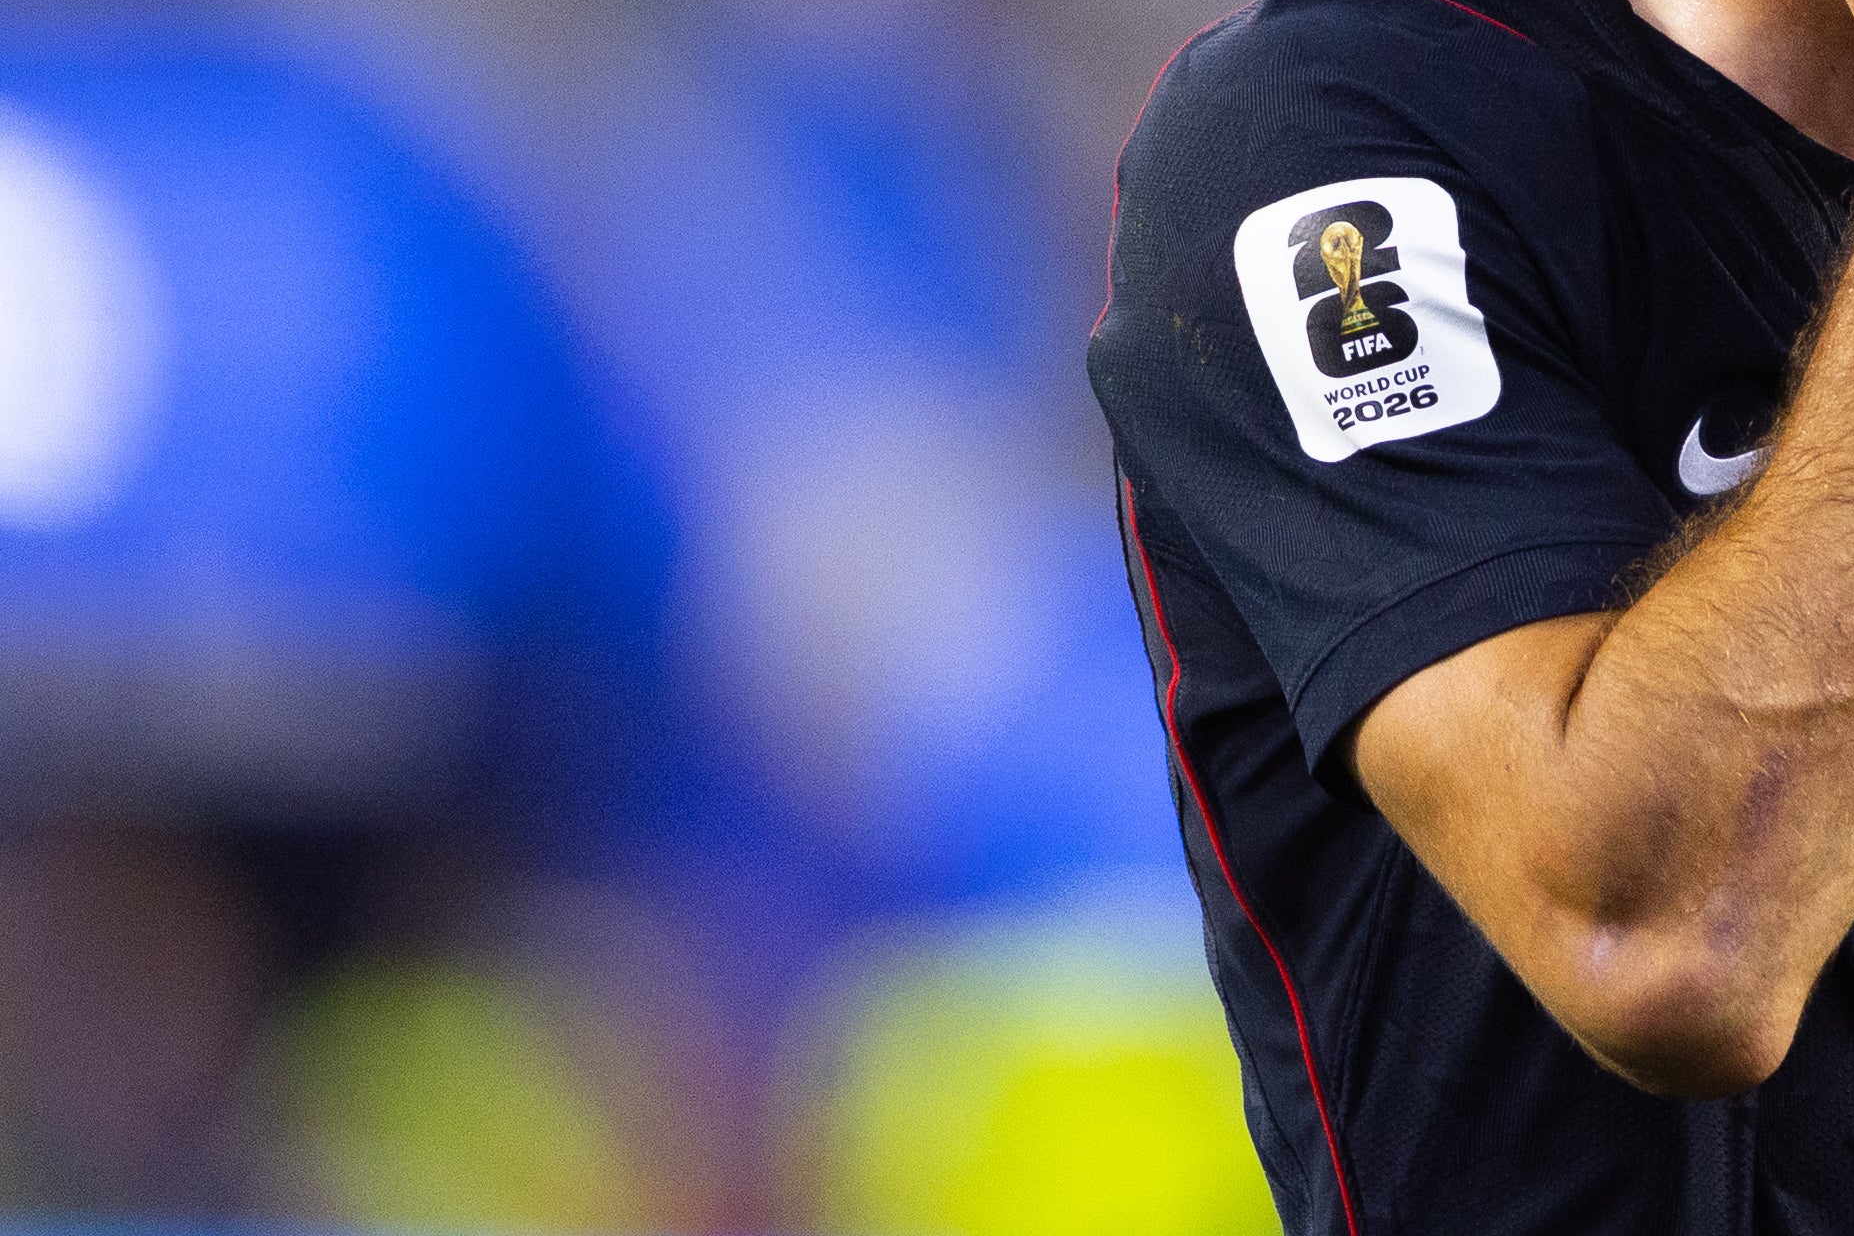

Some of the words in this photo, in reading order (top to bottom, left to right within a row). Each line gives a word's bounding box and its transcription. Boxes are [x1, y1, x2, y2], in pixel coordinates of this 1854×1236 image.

[1342, 333, 1393, 362] FIFA
[1325, 377, 1391, 406] WORLD
[1393, 365, 1430, 386] CUP
[1333, 384, 1439, 432] 2026
